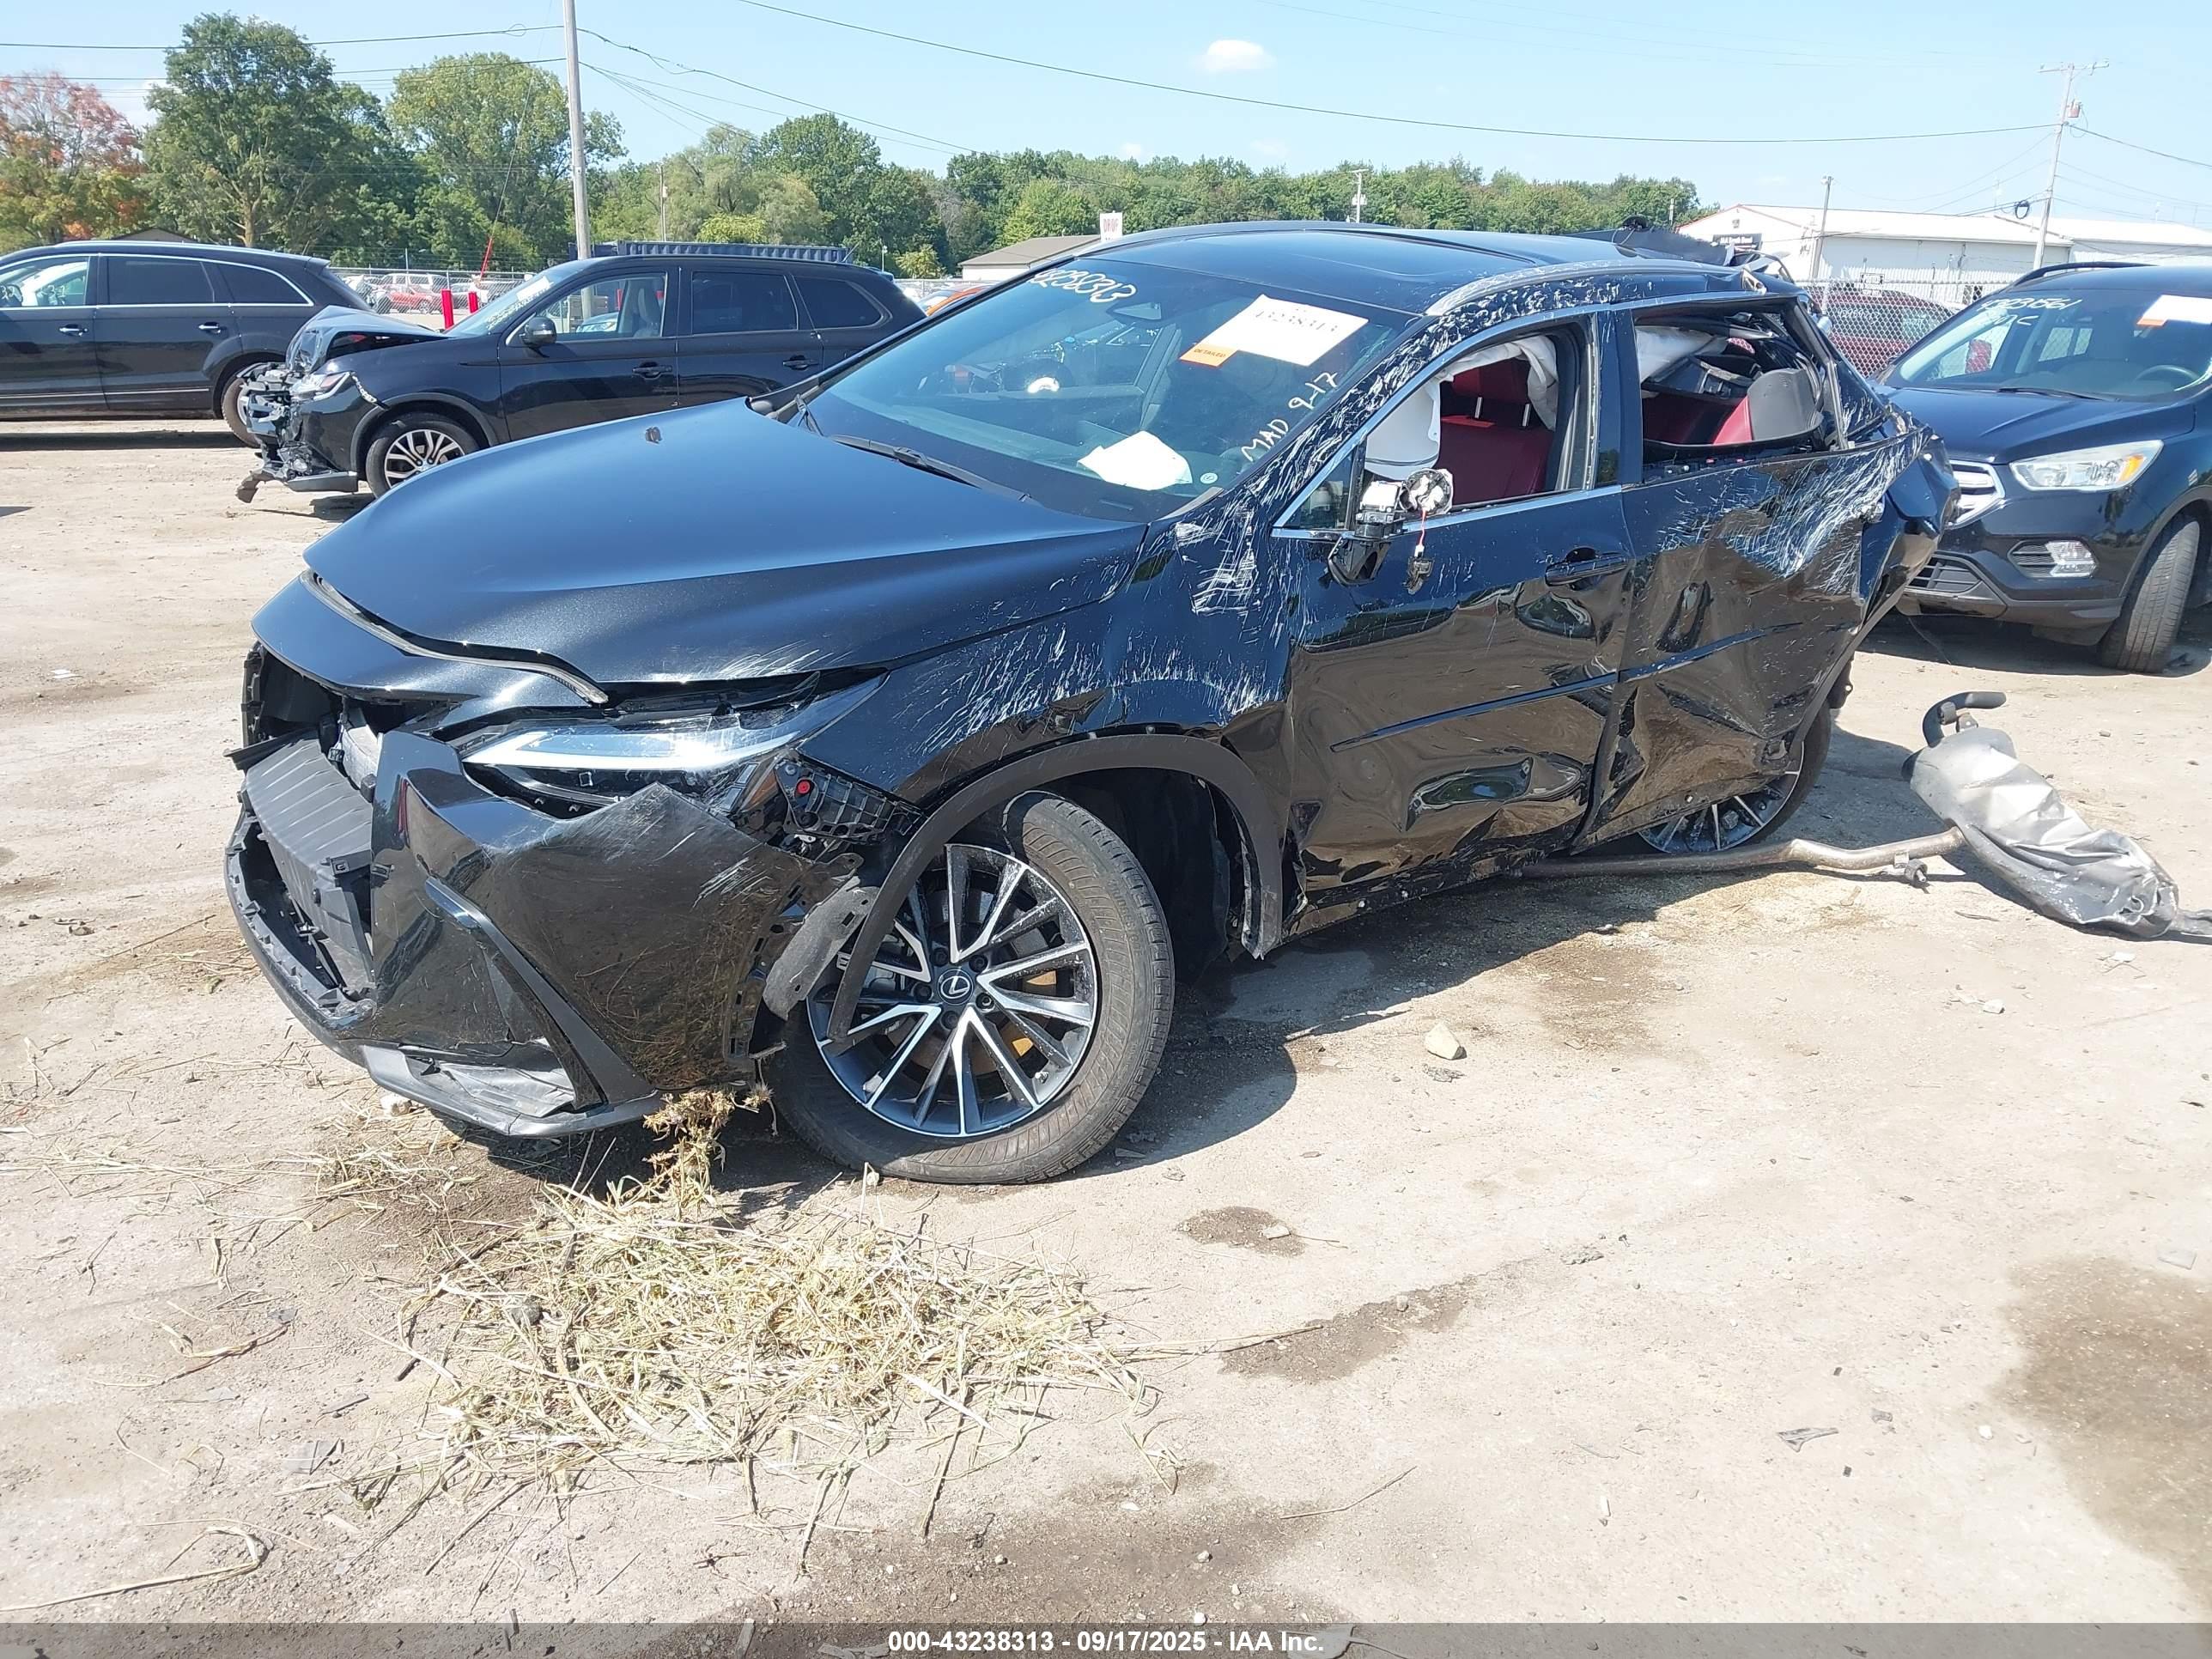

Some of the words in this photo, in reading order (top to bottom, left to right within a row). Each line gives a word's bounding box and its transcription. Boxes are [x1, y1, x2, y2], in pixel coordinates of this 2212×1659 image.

[1103, 218, 1120, 234] DROP
[1241, 418, 1290, 462] MAD
[1288, 372, 1339, 410] 9-17
